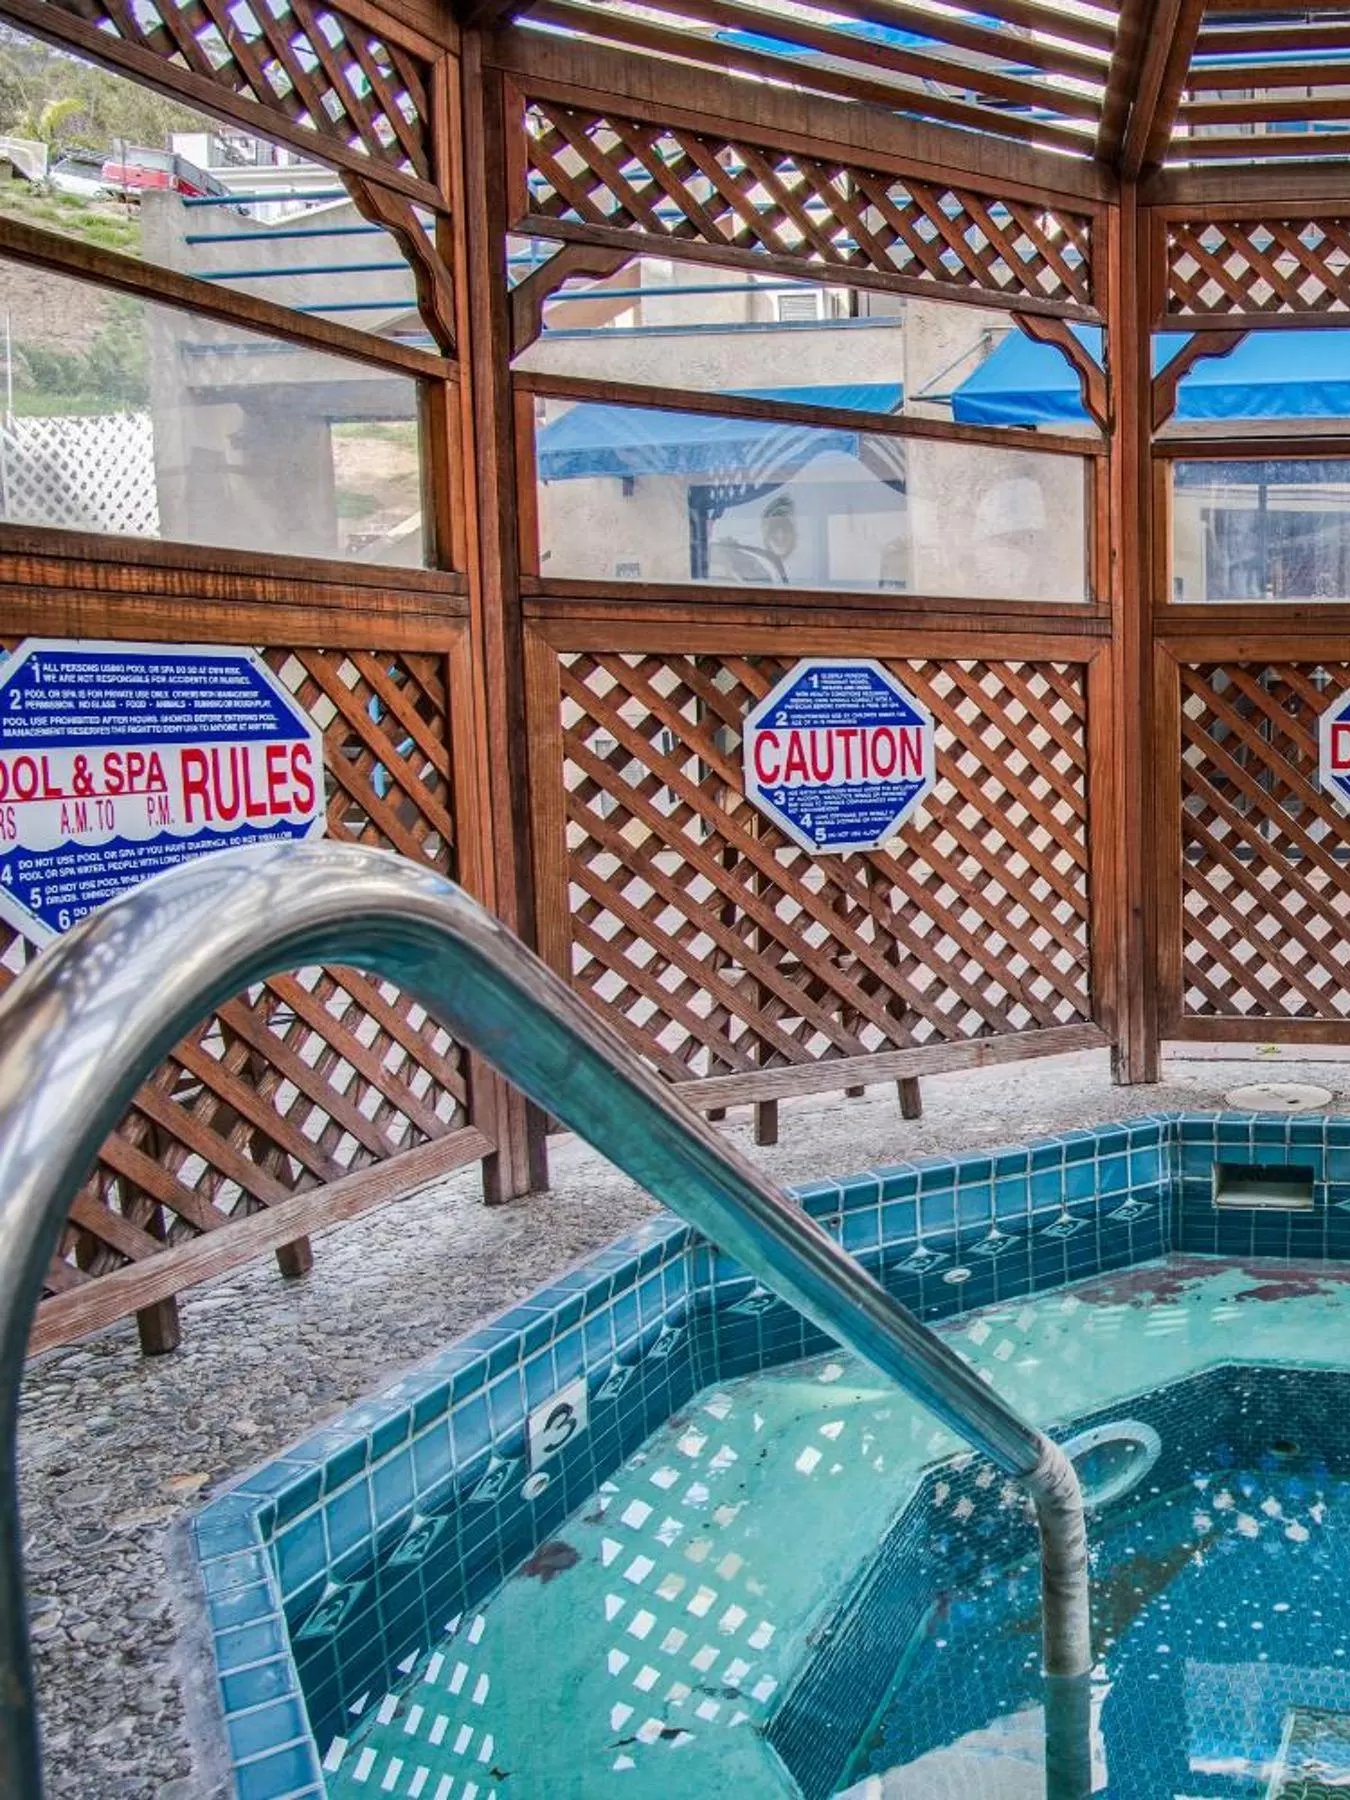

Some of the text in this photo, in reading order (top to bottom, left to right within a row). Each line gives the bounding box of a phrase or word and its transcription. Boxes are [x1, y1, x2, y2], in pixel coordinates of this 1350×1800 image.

[808, 674, 819, 689] 1
[9, 689, 22, 710] 2
[3, 718, 28, 726] POOL
[775, 711, 788, 726] 2
[754, 727, 923, 785] CAUTION
[73, 754, 96, 795] &
[104, 751, 167, 794] SPA
[180, 743, 316, 823] RULES
[774, 790, 786, 805] 3
[60, 801, 93, 834] A.M.
[95, 799, 115, 831] TO
[147, 796, 175, 826] P.M.
[800, 813, 813, 828] 4
[815, 828, 827, 841] 5
[18, 859, 33, 870] DO
[35, 857, 54, 868] NOT
[56, 854, 75, 865] USE
[77, 852, 102, 863] POOL
[104, 850, 118, 860] OR
[19, 870, 44, 881] POOL
[45, 868, 58, 879] OR
[107, 859, 140, 871] PEOPLE
[2, 863, 13, 886] 4
[60, 881, 77, 892] NOT
[79, 879, 97, 891] USE
[97, 876, 120, 888] POOL
[30, 887, 42, 909] 5
[58, 909, 71, 930] 6
[73, 906, 88, 917] DO
[544, 1403, 577, 1453] 3
